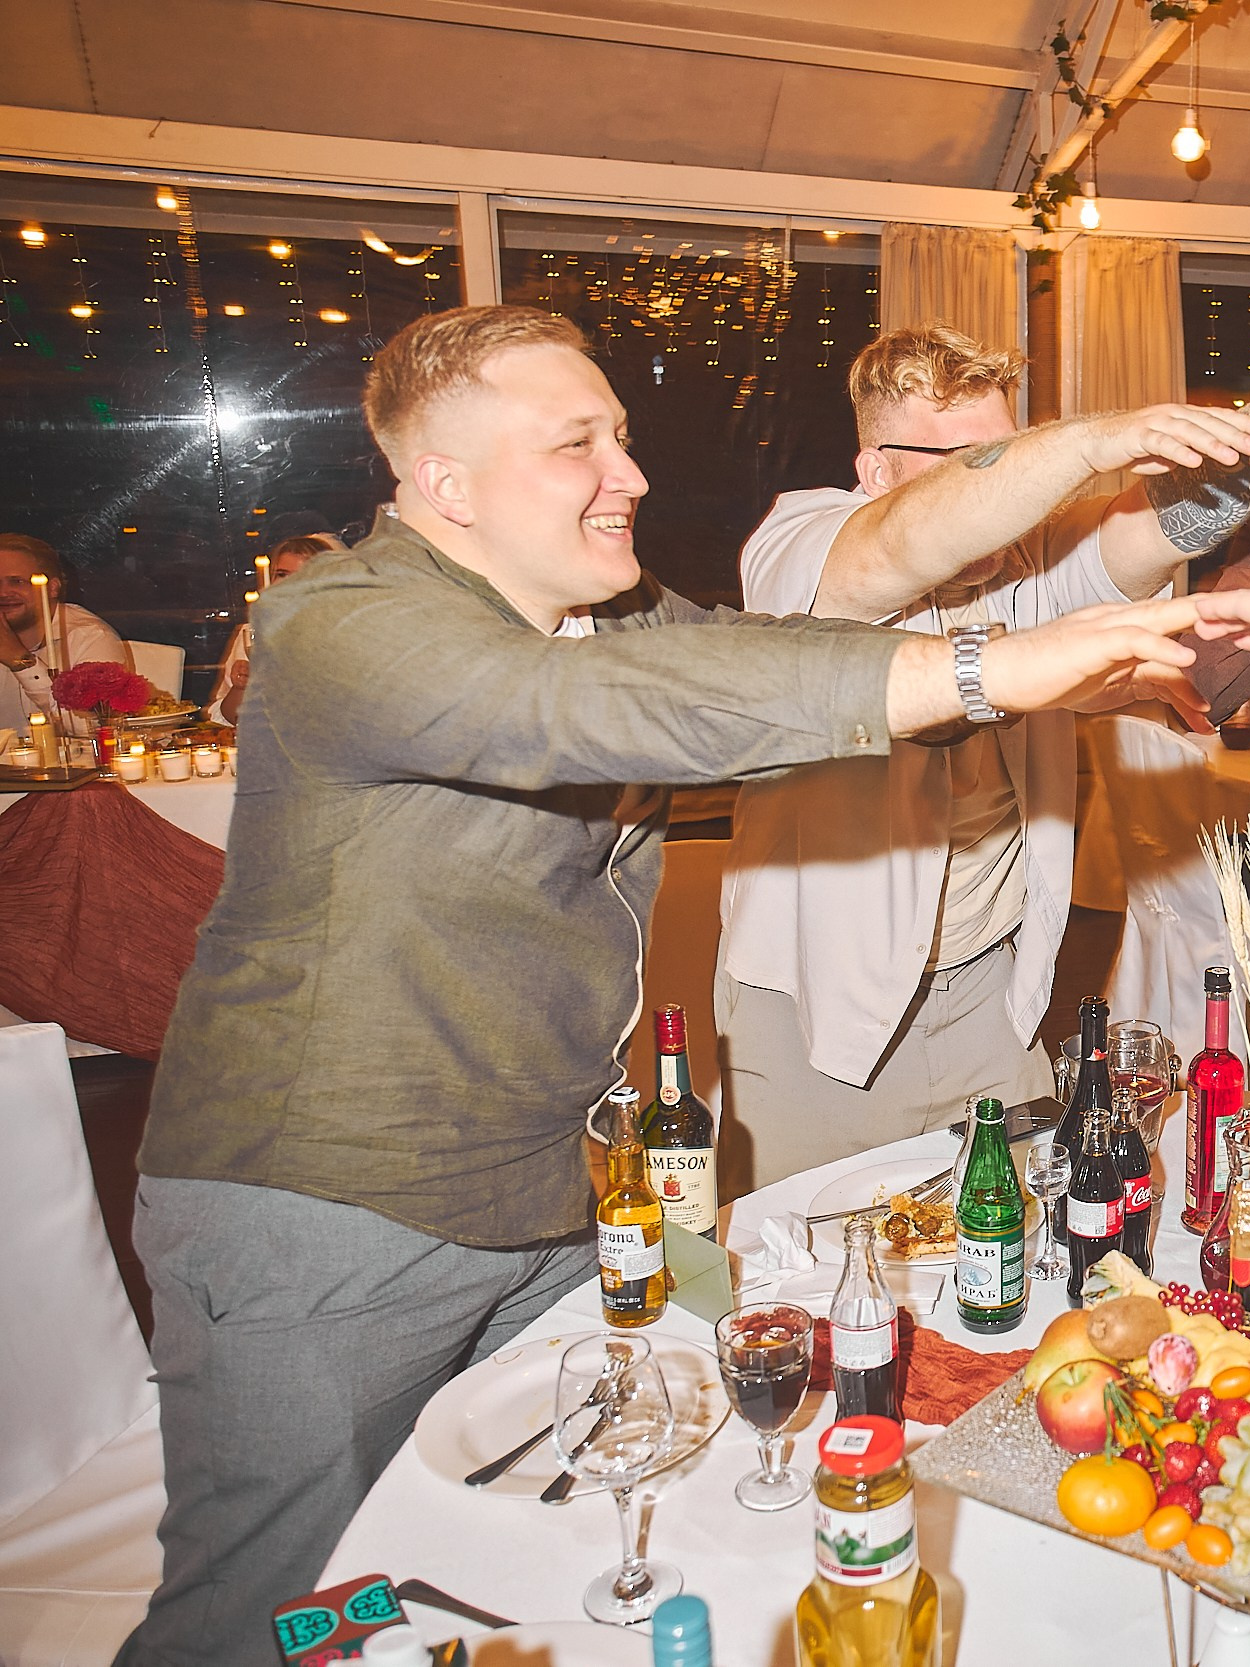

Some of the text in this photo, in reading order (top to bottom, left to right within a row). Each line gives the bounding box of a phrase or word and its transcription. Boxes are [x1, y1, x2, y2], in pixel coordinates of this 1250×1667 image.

[646, 1155, 709, 1170] AMESON
[597, 1228, 636, 1244] orona
[958, 1240, 996, 1257] IRAB
[961, 1284, 996, 1299] ИРАБ
